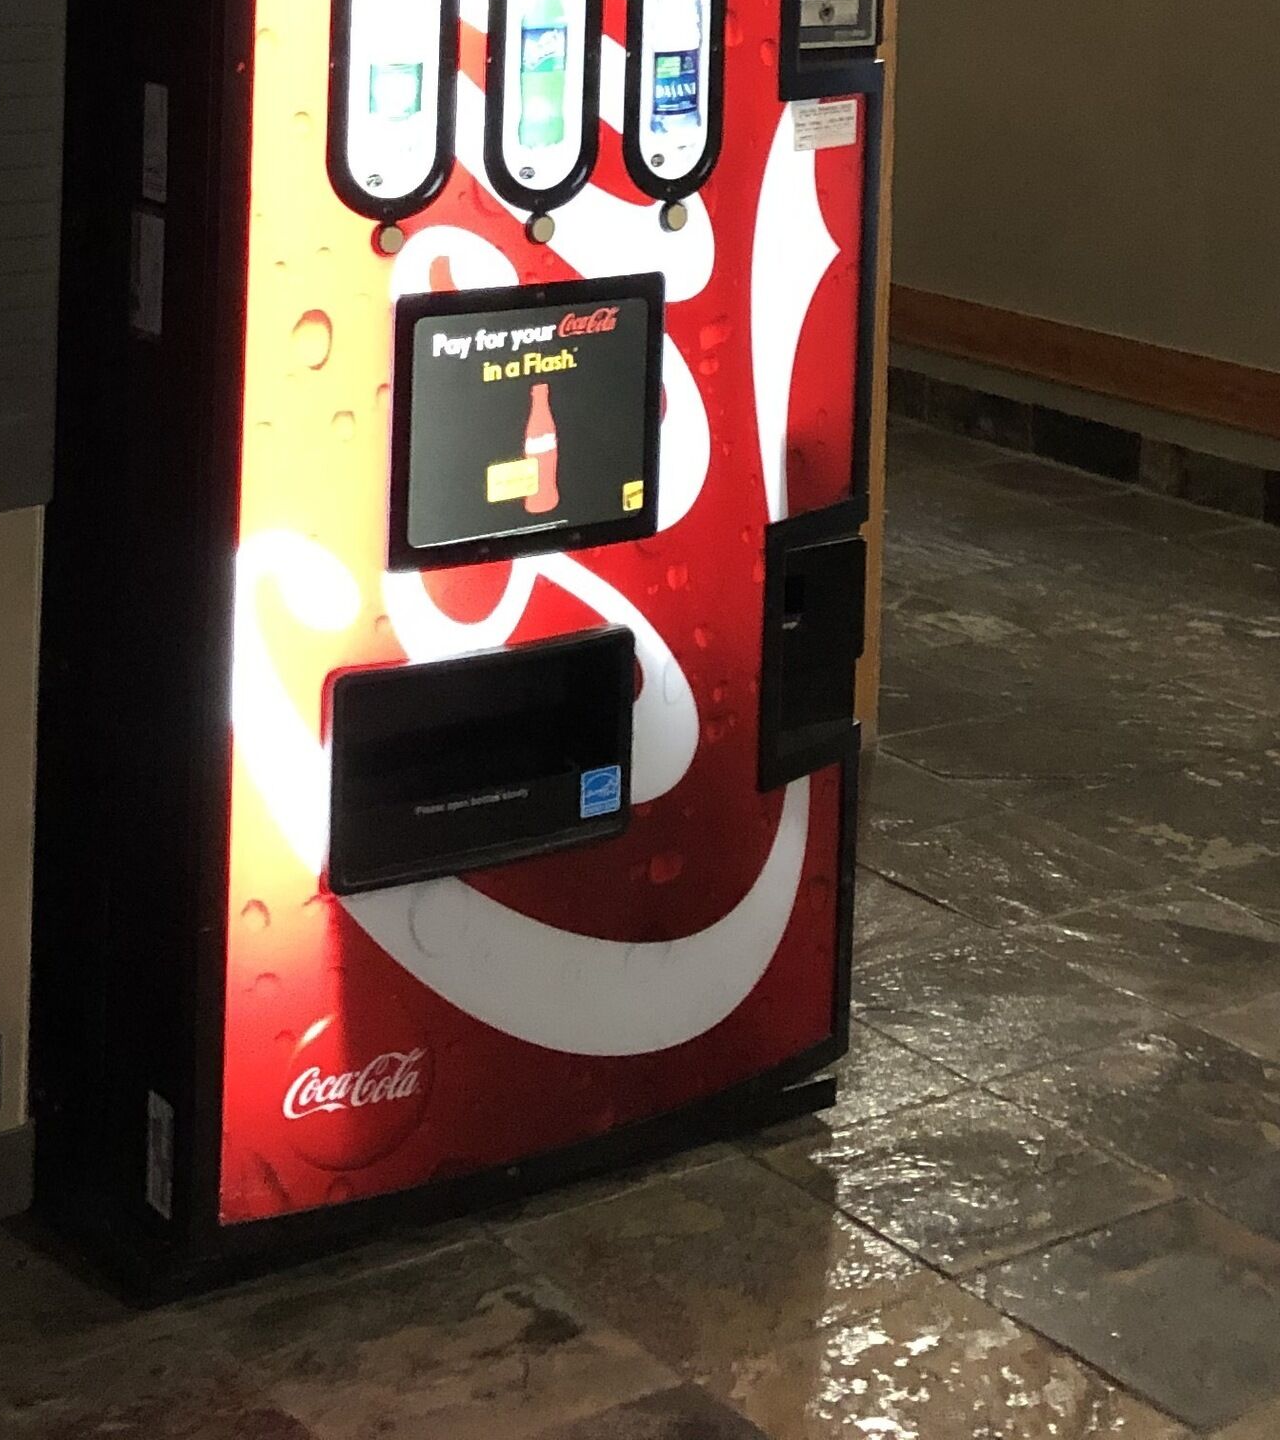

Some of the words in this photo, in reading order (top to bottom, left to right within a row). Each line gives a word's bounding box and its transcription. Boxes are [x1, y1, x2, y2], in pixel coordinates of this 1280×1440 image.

[655, 81, 697, 101] DASANI
[432, 332, 471, 359] Pay
[475, 329, 507, 352] for
[511, 324, 556, 351] your
[558, 306, 619, 338] Coca-Cola
[483, 362, 501, 383] in
[506, 360, 521, 378] a
[282, 1047, 429, 1120] Coca-Cola
